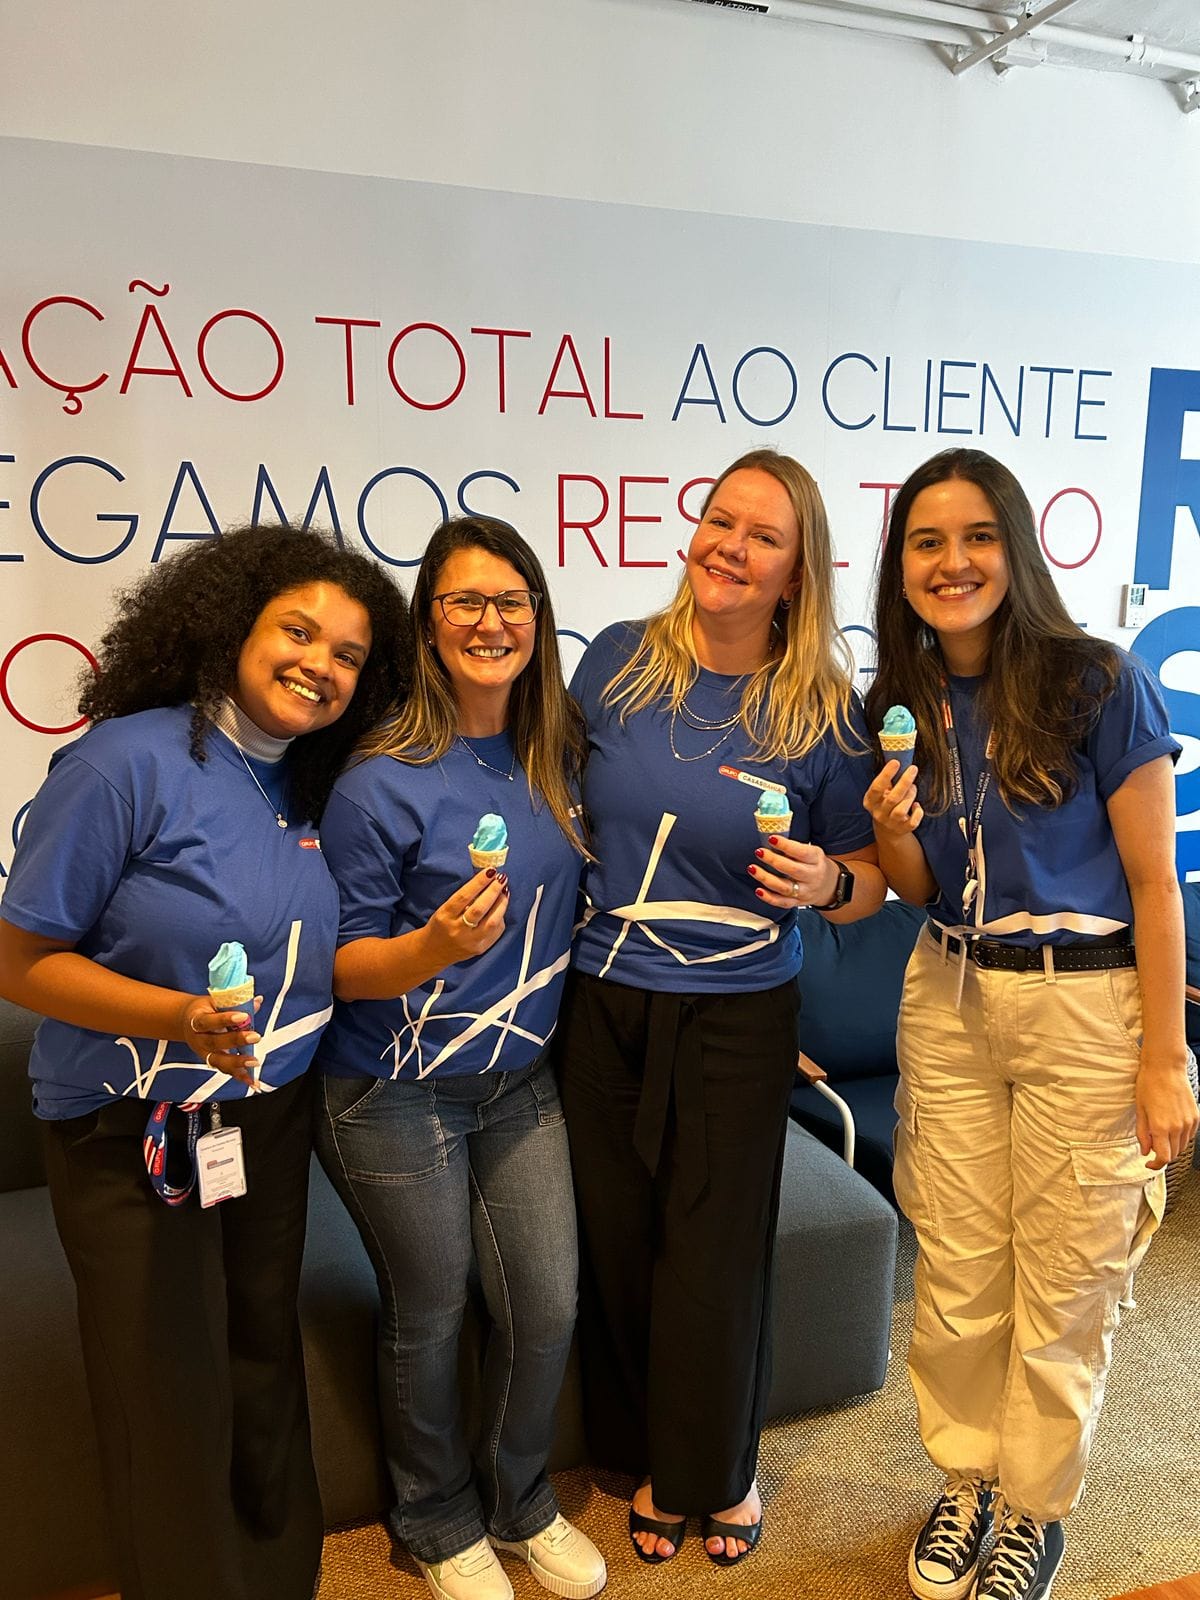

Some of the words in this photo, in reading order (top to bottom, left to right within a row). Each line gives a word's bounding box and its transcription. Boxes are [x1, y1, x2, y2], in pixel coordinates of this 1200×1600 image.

[0, 279, 284, 415] ÇÃO
[314, 315, 644, 420] TOTAL
[671, 343, 798, 428] AO
[822, 352, 1112, 441] CLIENTE
